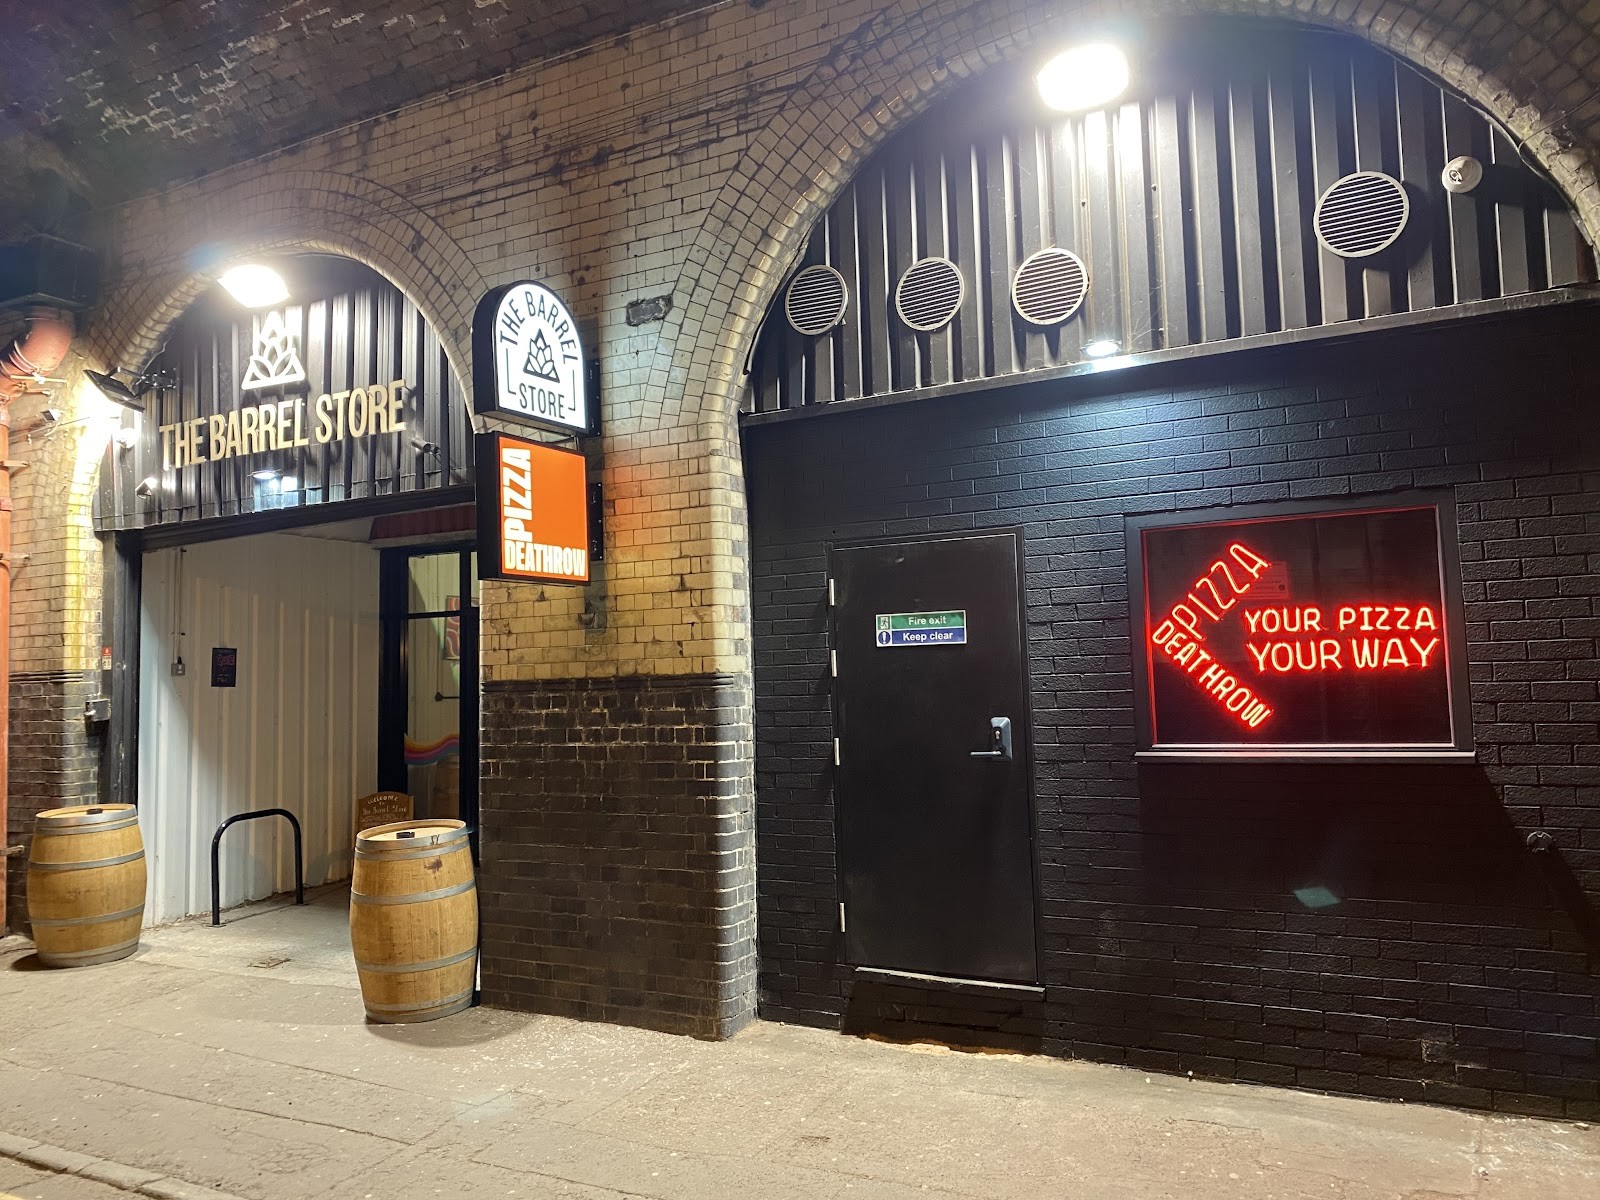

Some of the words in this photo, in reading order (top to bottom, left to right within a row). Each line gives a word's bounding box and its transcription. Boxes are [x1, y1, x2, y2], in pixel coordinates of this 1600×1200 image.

[500, 298, 525, 346] THE
[525, 291, 579, 364] BARREL
[519, 383, 566, 419] STORE
[159, 416, 207, 471] THE
[209, 398, 310, 462] BARREL
[315, 379, 406, 444] STORE
[502, 448, 533, 542] PIZZA
[504, 539, 586, 577] DEATHROW
[1172, 544, 1269, 640] PIZZA
[902, 632, 927, 642] Keep
[929, 631, 954, 640] clear
[908, 617, 927, 625] Fire
[929, 615, 947, 624] exit
[1244, 605, 1322, 633] YOUR
[1338, 606, 1436, 632] PIZZA
[1247, 638, 1343, 673] YOUR
[1351, 637, 1441, 669] WAY
